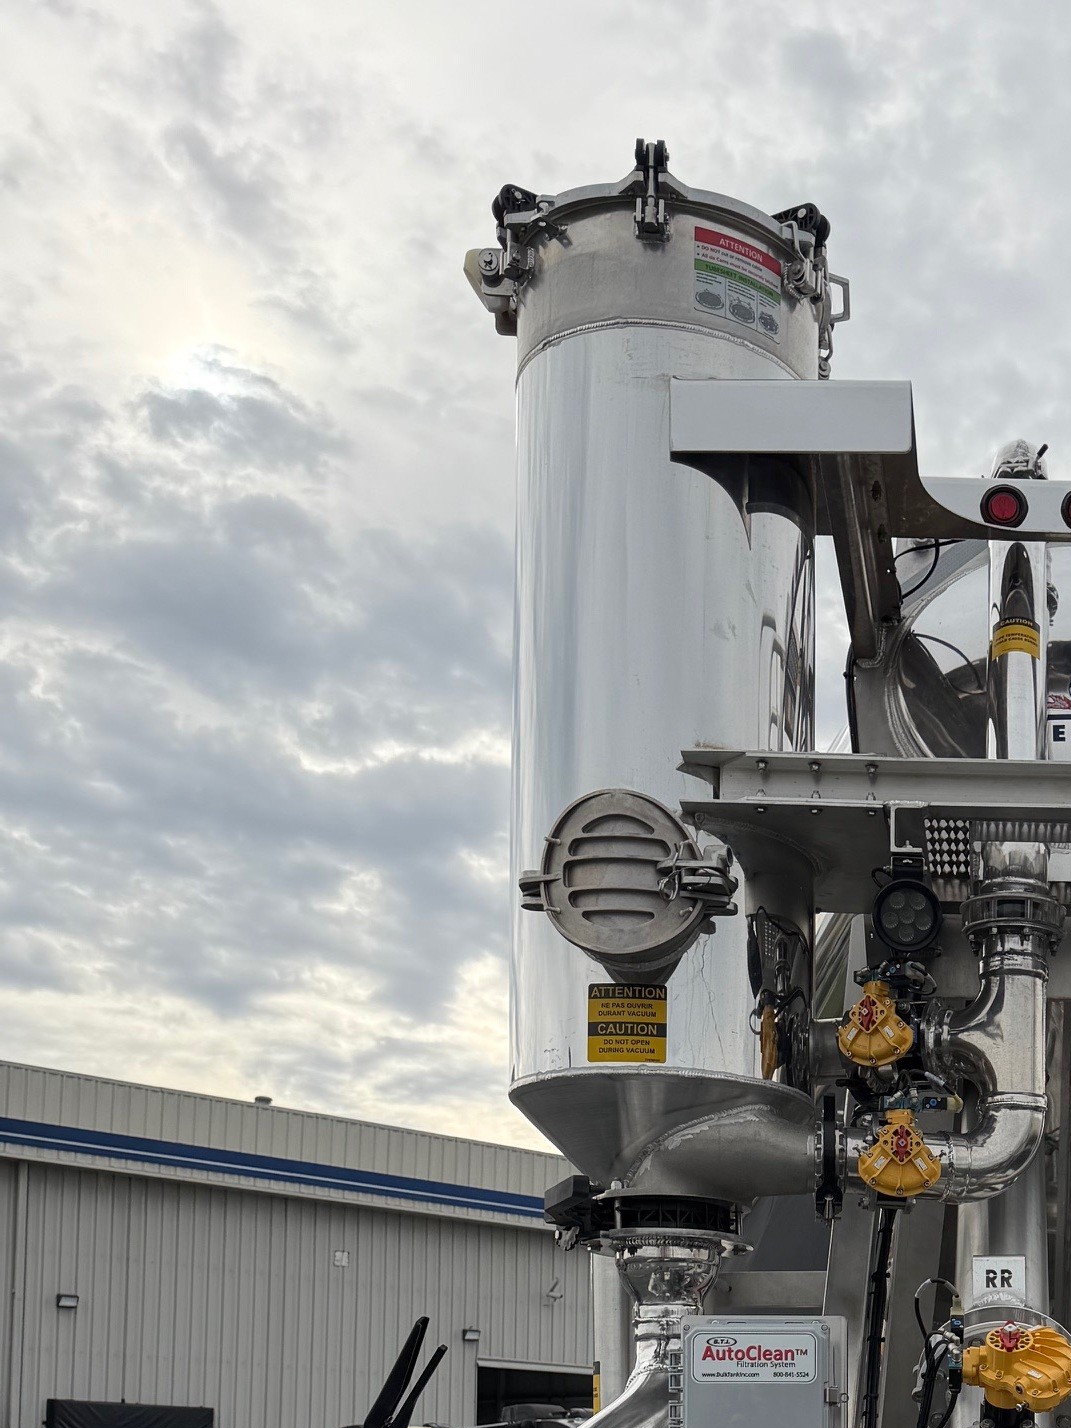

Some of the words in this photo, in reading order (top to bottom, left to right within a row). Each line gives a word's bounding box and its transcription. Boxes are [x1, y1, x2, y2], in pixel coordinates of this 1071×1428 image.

[720, 238, 763, 262] ATTENTION
[1000, 618, 1033, 627] CAUTION
[591, 986, 665, 999] ATTENTION
[597, 1024, 657, 1035] CAUTION
[985, 1269, 1013, 1288] RR
[770, 1361, 796, 1369] System
